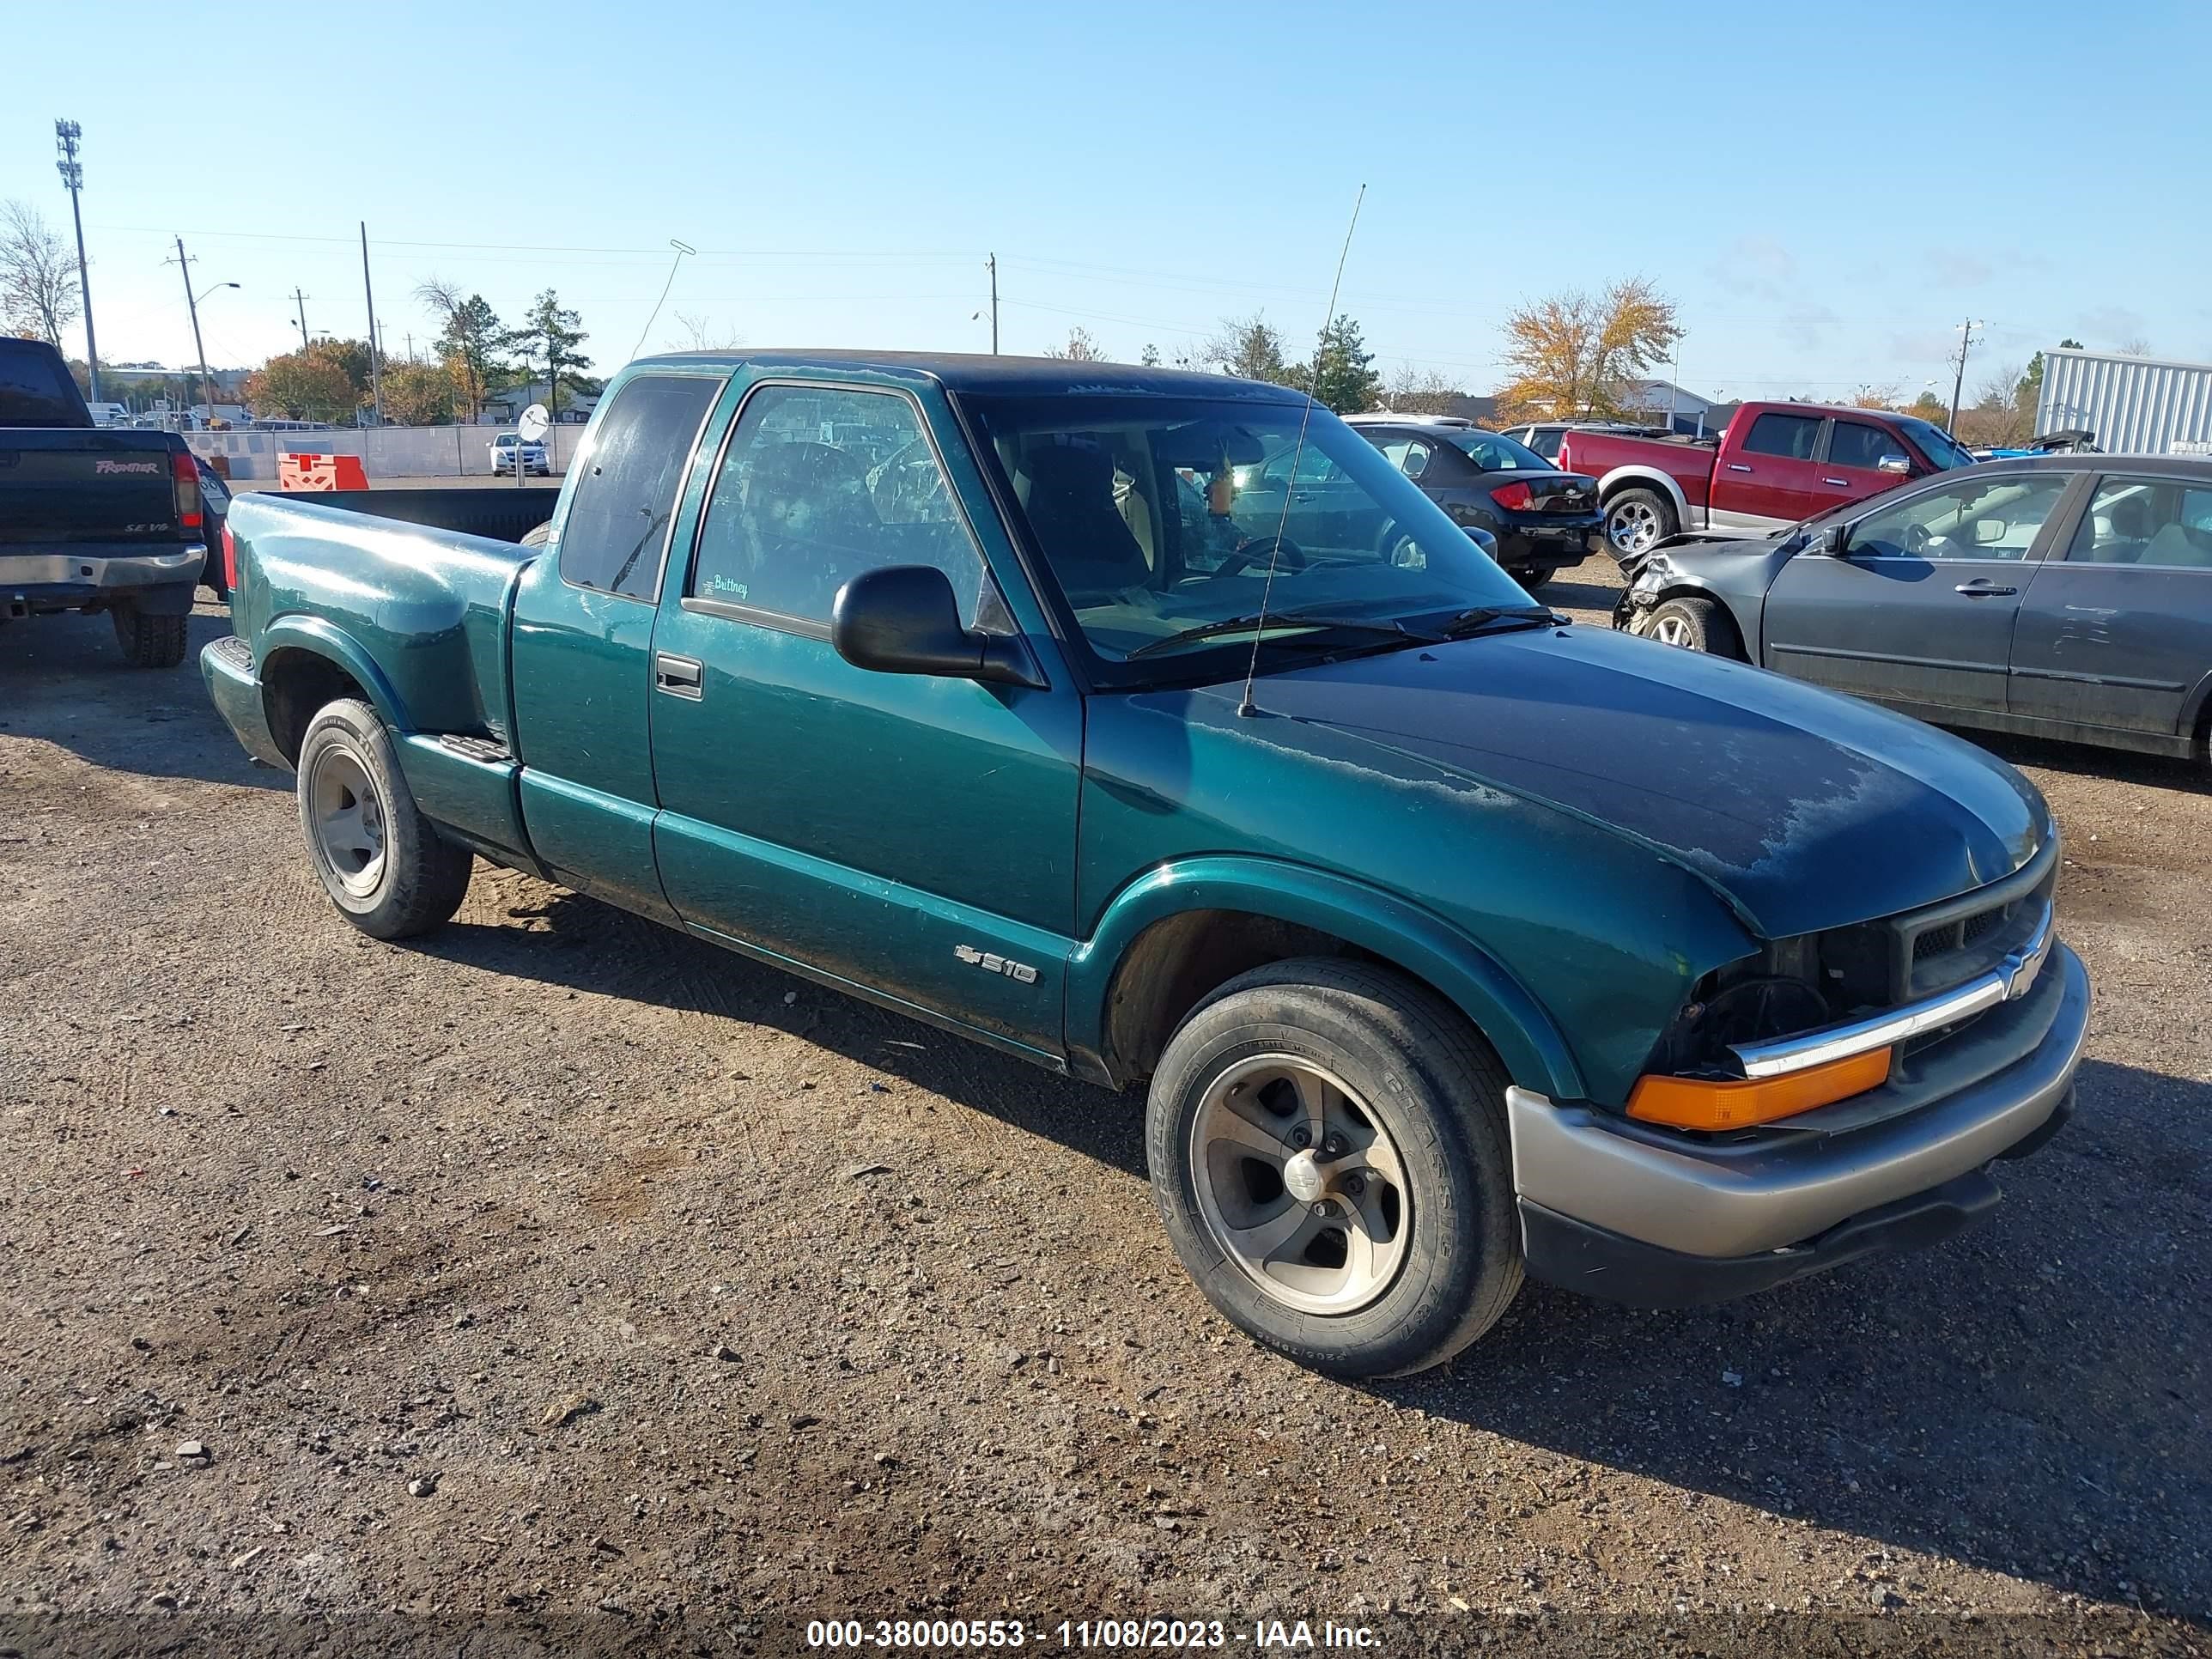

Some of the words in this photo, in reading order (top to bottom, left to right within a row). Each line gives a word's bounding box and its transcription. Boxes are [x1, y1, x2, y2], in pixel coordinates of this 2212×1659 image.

[95, 459, 160, 474] FRONTIER
[124, 523, 146, 532] SE
[149, 522, 169, 532] V6
[714, 574, 748, 599] Brittney
[981, 952, 1038, 984] S10
